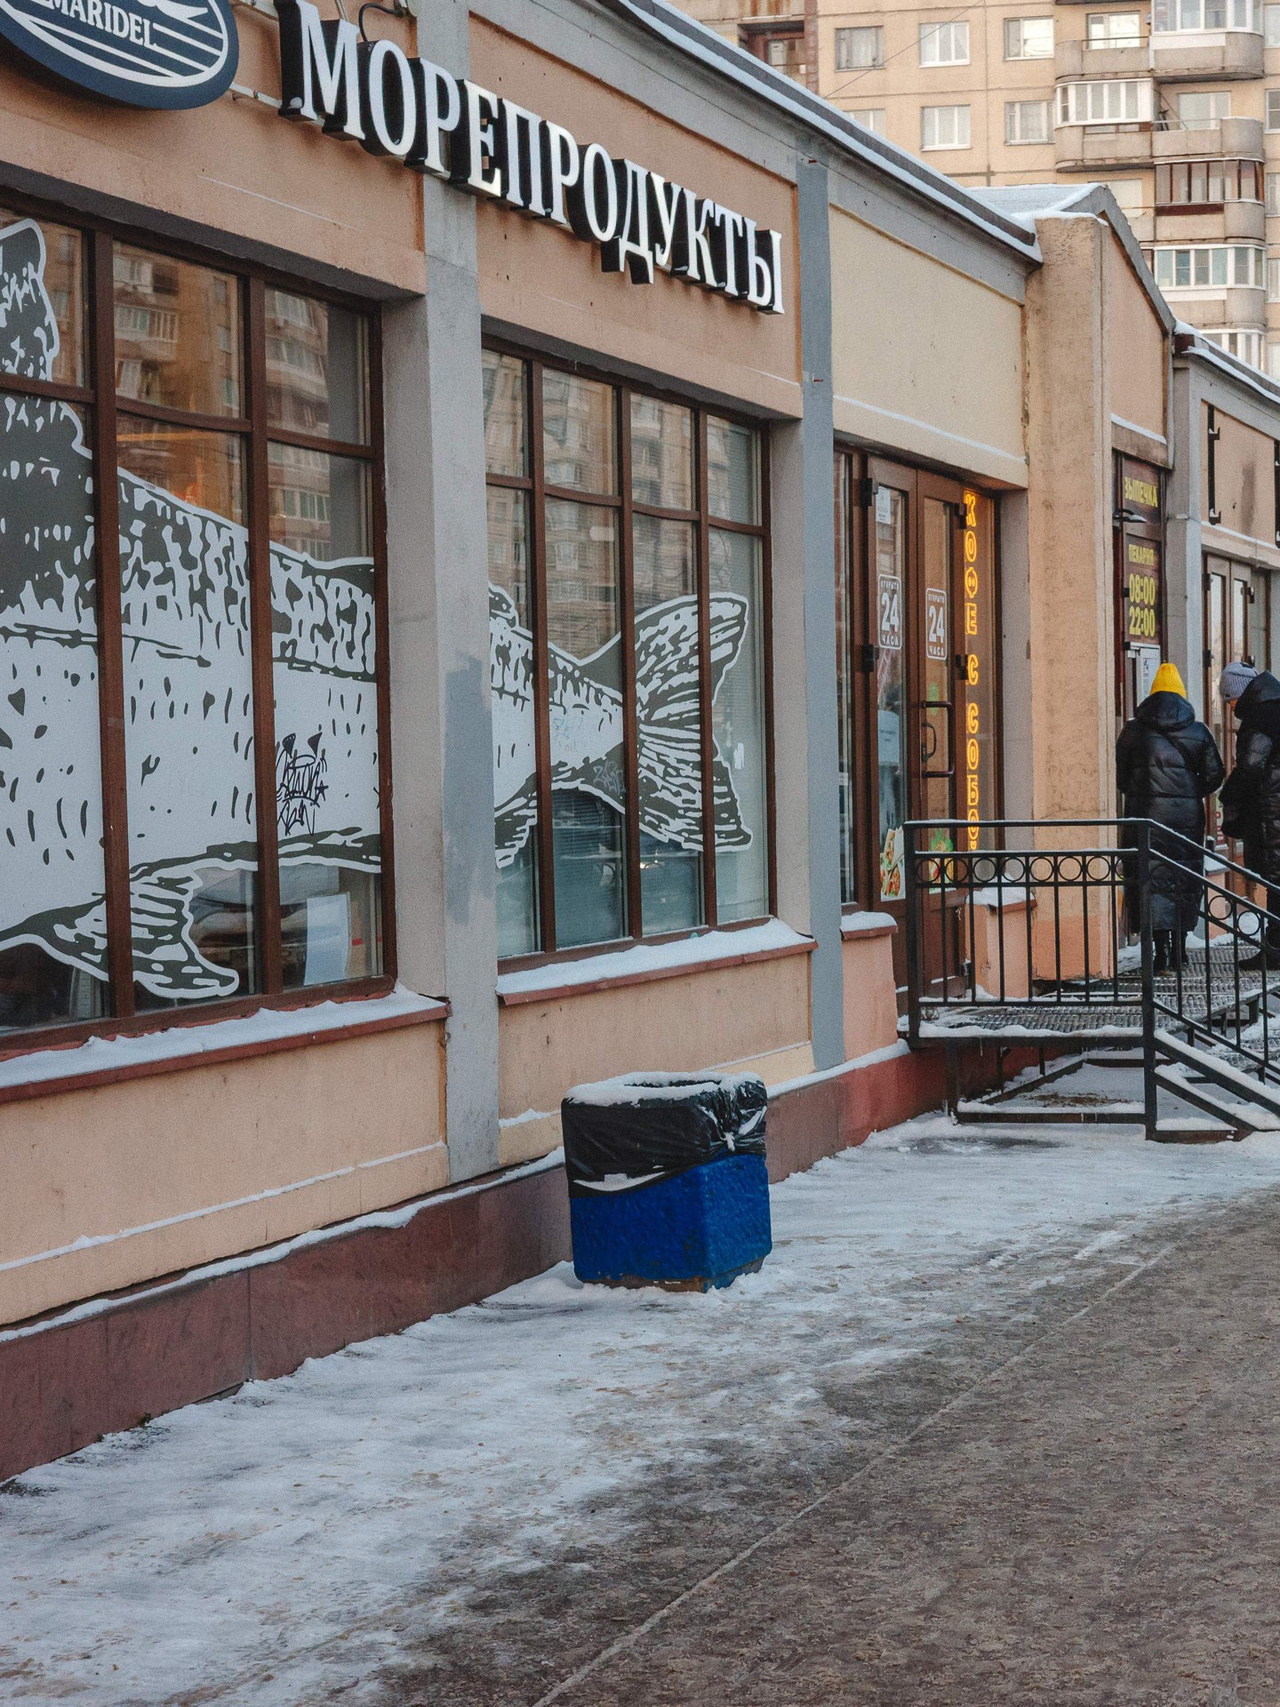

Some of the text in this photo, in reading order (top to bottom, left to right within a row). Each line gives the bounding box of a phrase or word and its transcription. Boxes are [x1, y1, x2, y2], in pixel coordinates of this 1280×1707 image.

[298, 0, 785, 315] МОРЕПРОДУКТЫ
[965, 493, 978, 636] КОФЕ
[1129, 572, 1156, 606] 08:00
[881, 592, 900, 632] 24
[929, 605, 945, 643] 24
[1129, 605, 1156, 638] 22:00
[881, 634, 899, 646] ЧАСА
[929, 645, 945, 656] ЧАСА
[967, 702, 980, 850] СОБО
